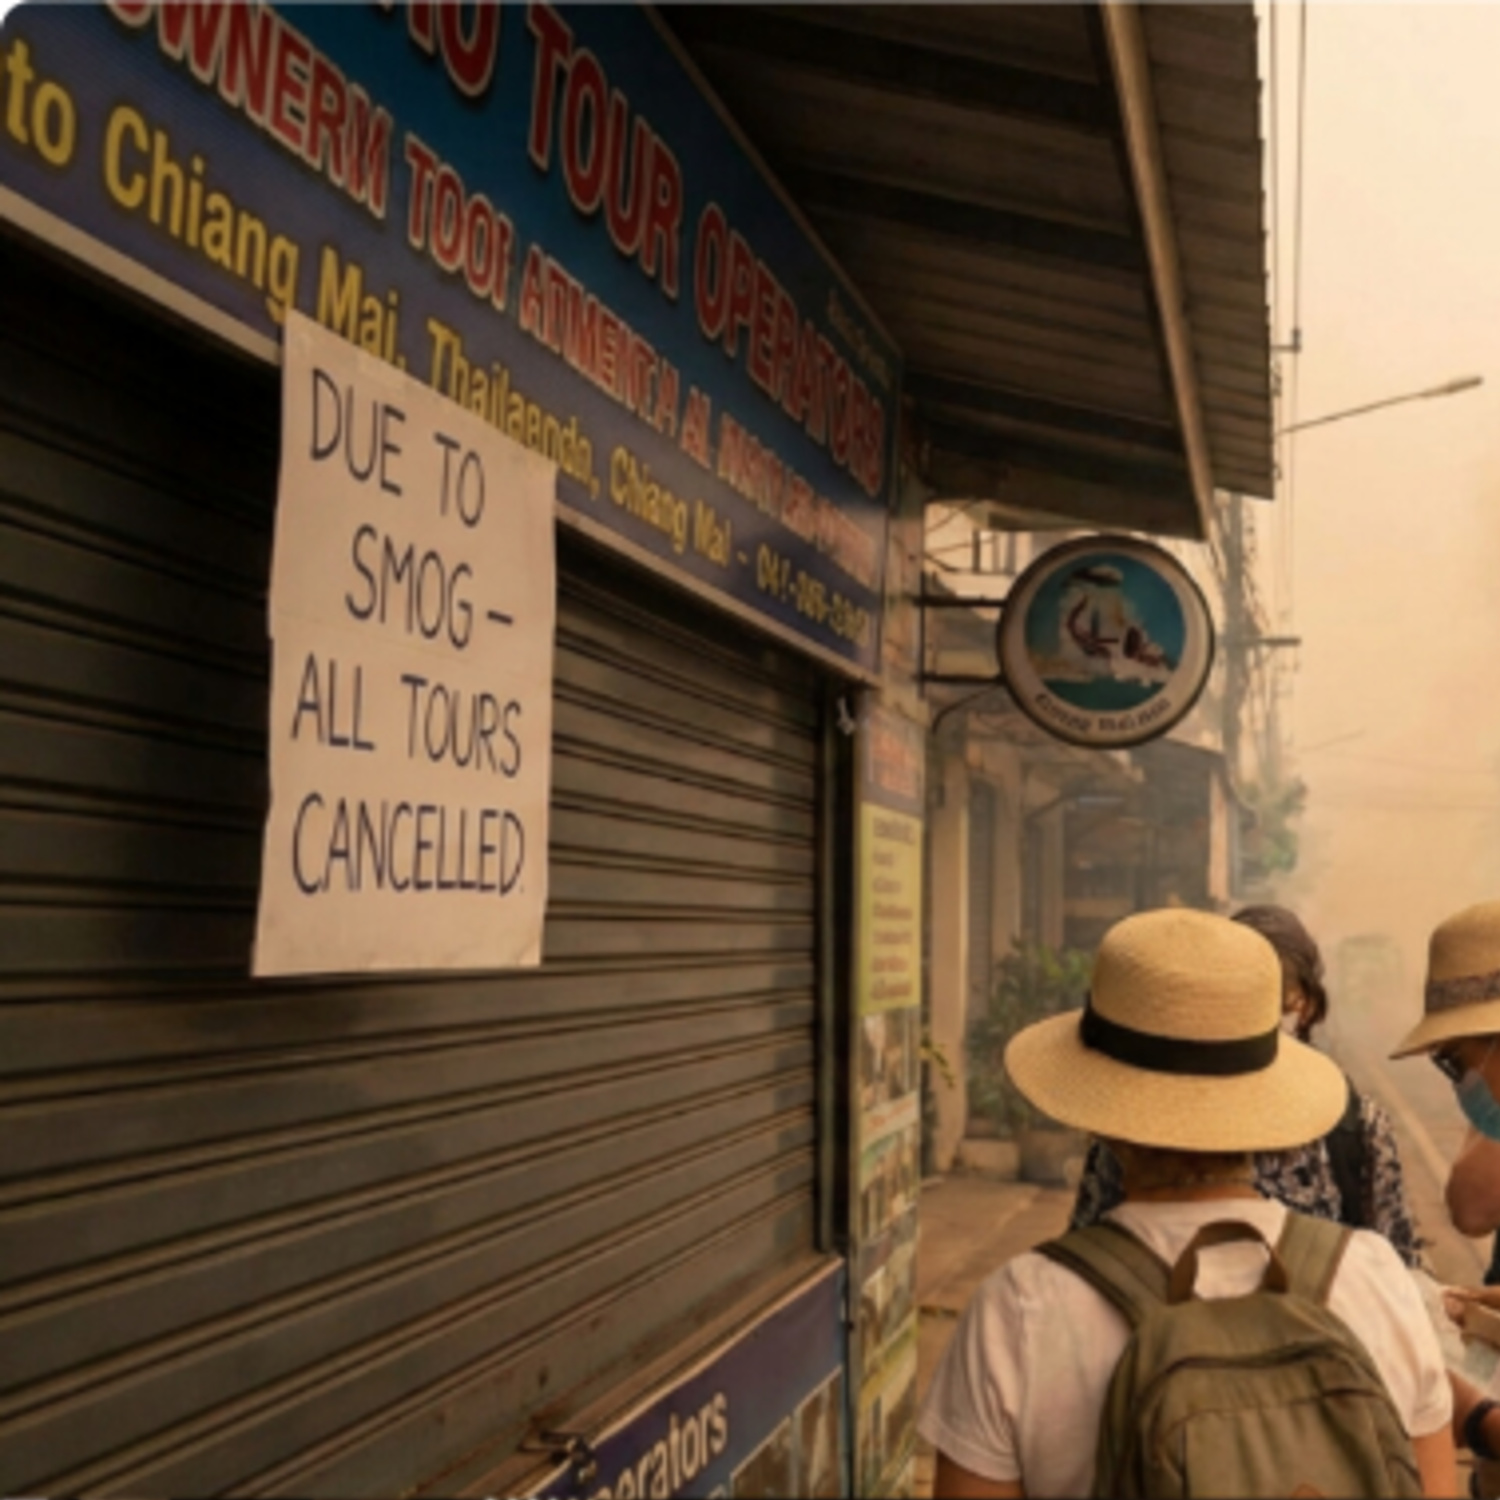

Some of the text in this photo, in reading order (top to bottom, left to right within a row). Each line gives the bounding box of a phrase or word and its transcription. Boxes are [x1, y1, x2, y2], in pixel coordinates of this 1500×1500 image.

[7, 39, 74, 166] to
[105, 105, 299, 325] Chiang
[527, 4, 682, 298] TOUR
[311, 367, 486, 528] DUE TO
[291, 653, 522, 778] ALL TOURS
[292, 791, 526, 896] CANCELLED
